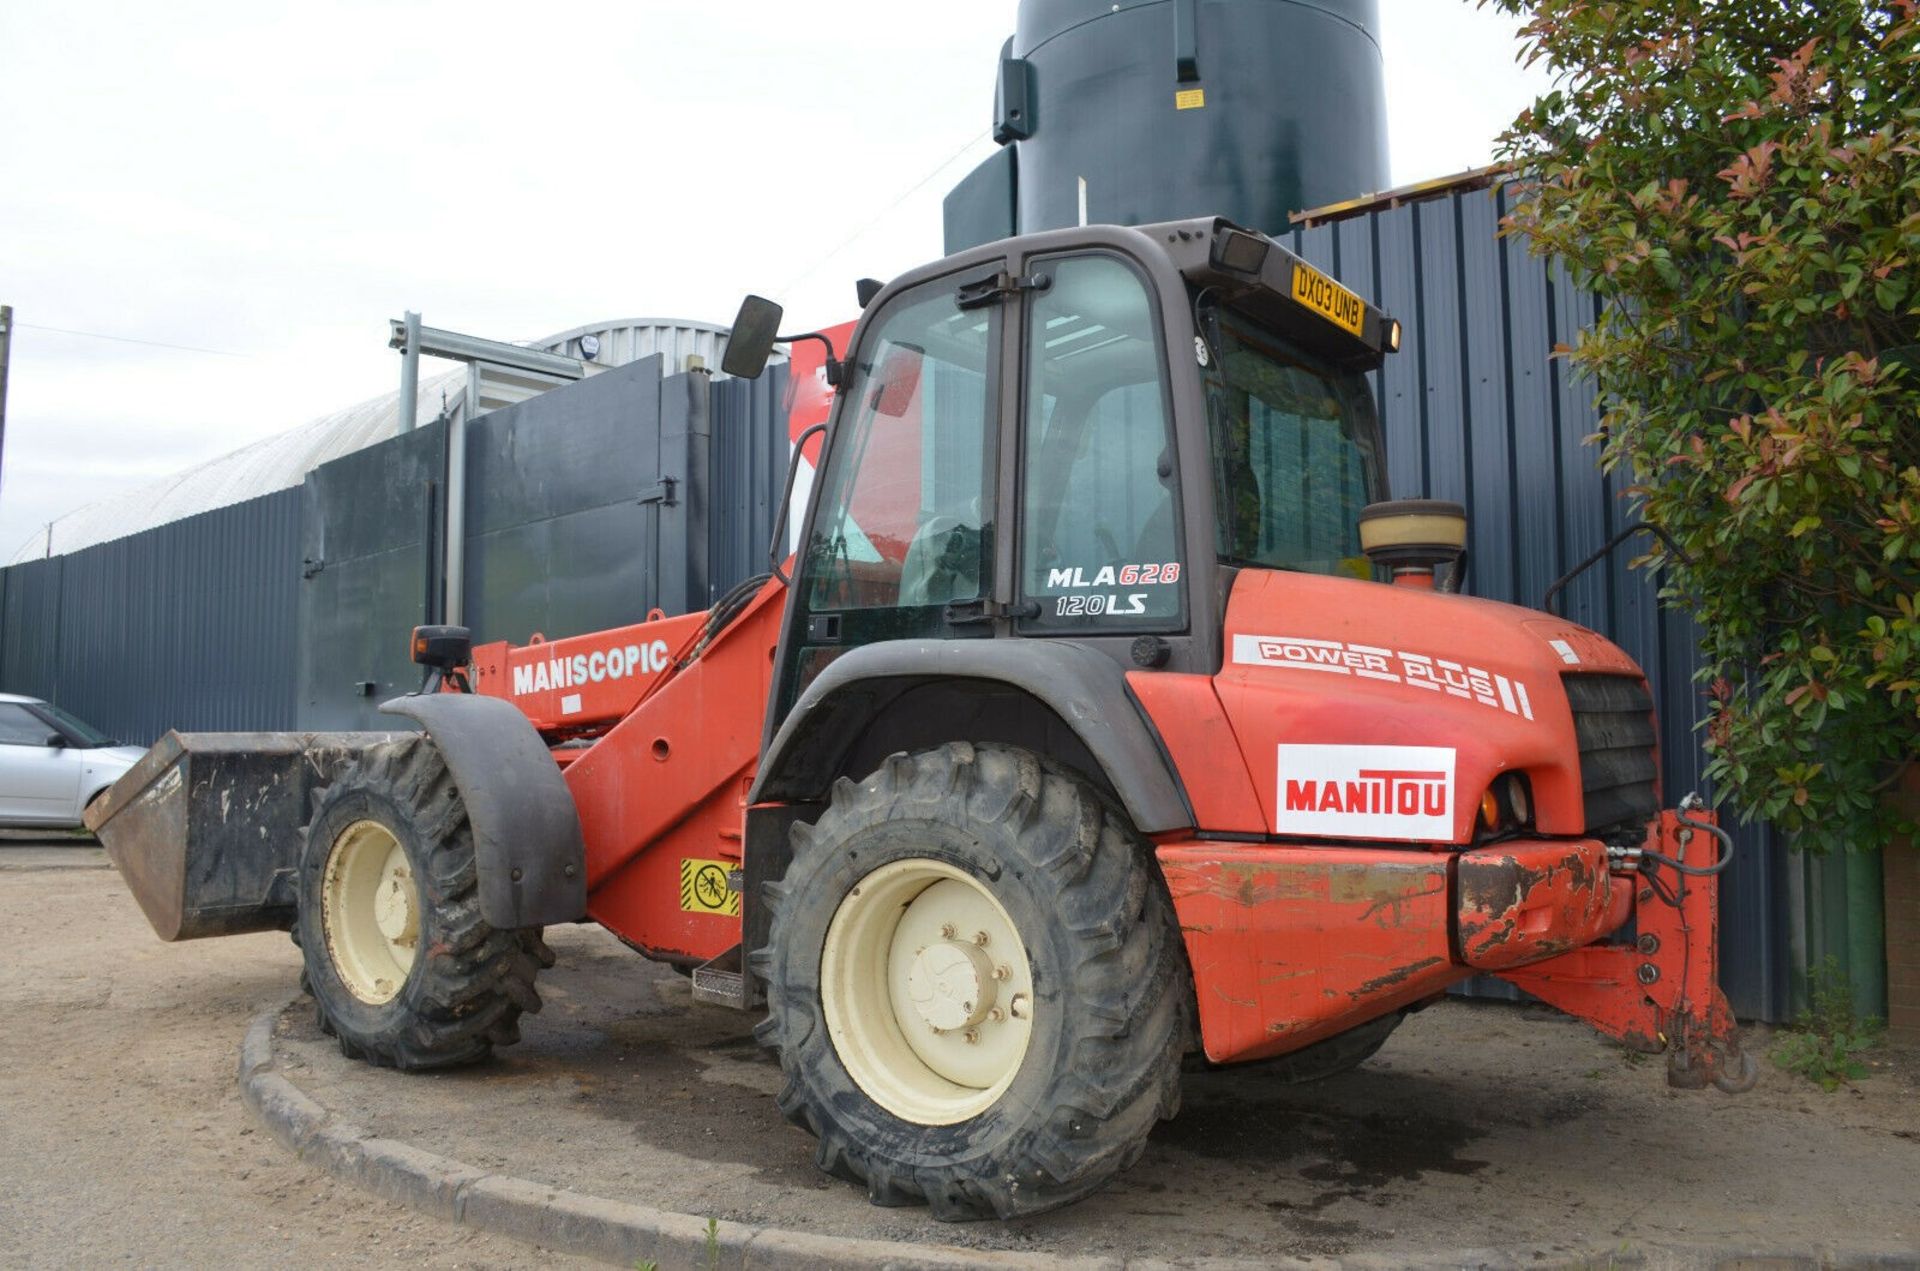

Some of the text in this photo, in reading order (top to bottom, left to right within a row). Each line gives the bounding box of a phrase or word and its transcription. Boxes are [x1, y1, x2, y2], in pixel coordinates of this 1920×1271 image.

[1299, 267, 1359, 327] DX03 UNB
[513, 639, 669, 696] MANISCOPIC
[1261, 642, 1494, 697] POWER PLUS
[1286, 769, 1446, 816] MANITOU
